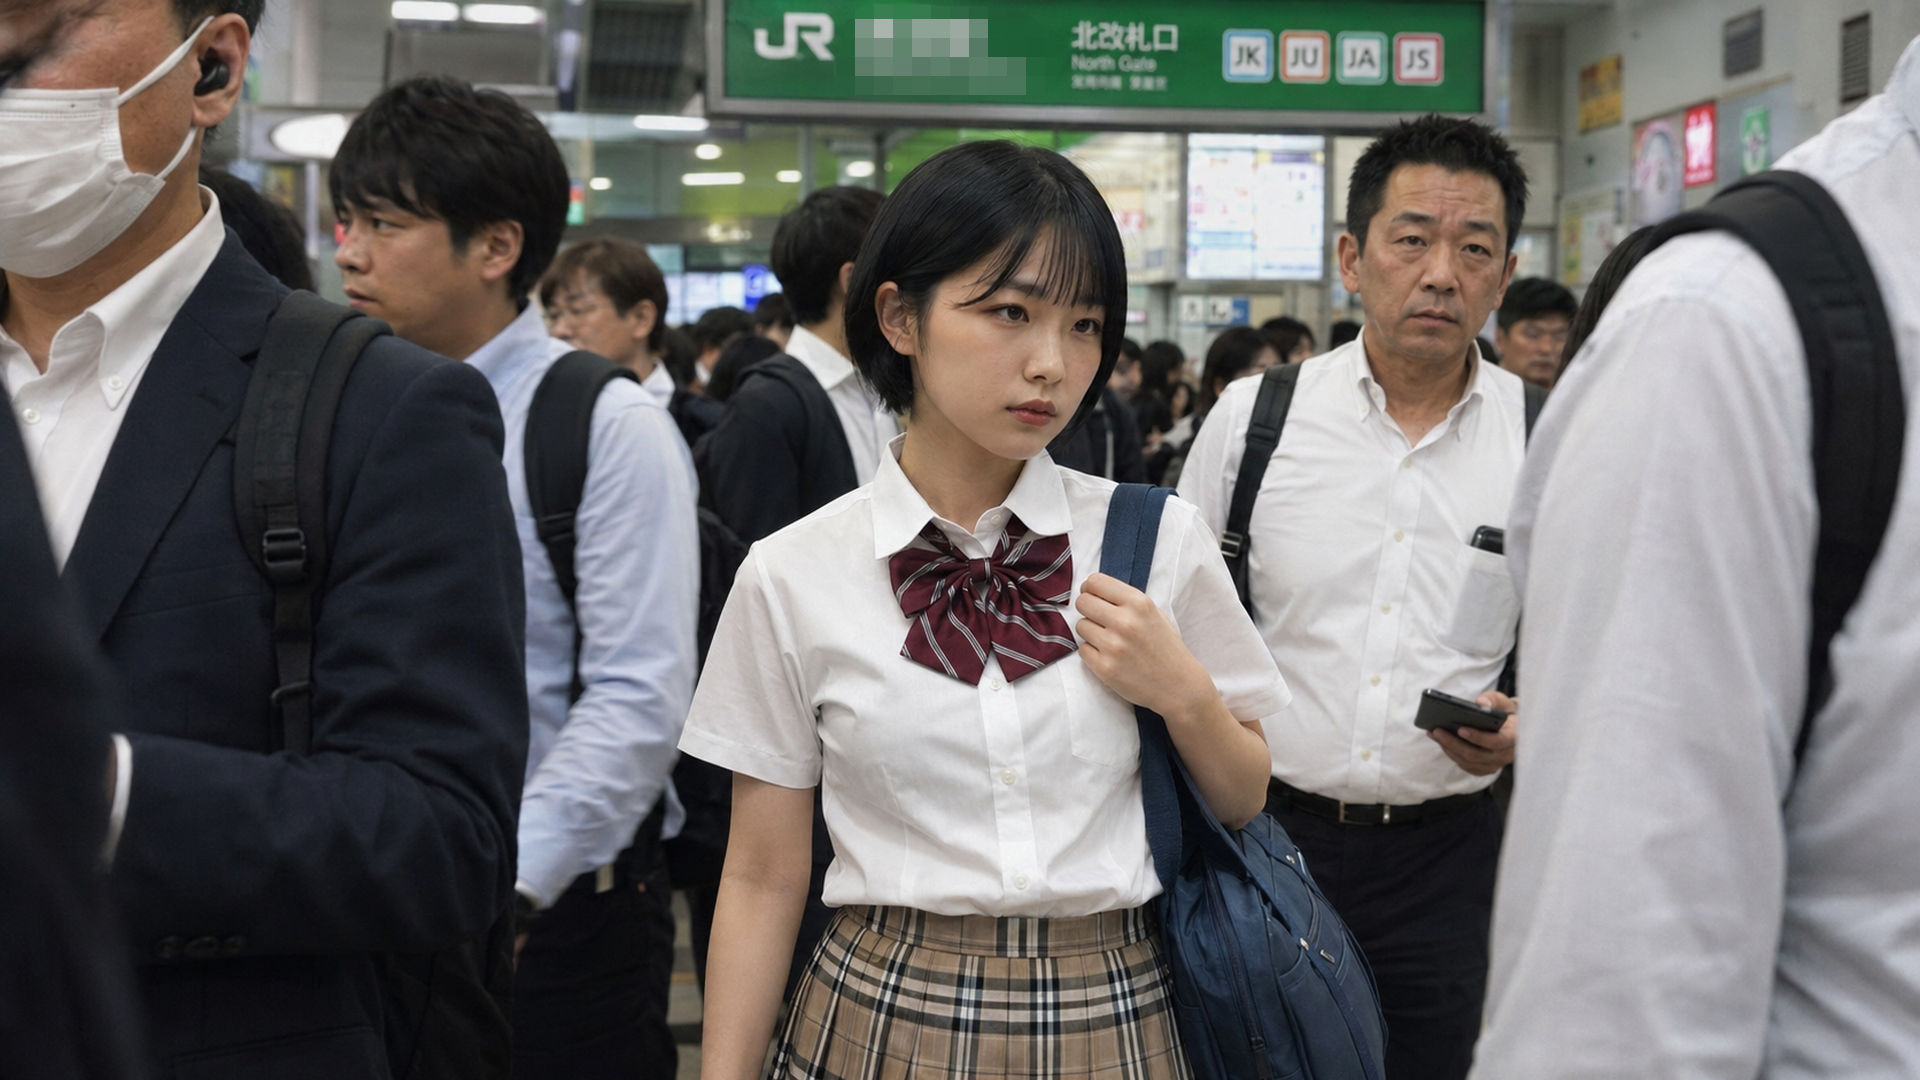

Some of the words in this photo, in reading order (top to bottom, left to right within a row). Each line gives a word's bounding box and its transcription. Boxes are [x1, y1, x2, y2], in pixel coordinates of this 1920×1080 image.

[754, 11, 835, 61] JR
[1071, 20, 1178, 51] 北改札口
[1071, 54, 1116, 71] North
[1118, 54, 1158, 72] Gate
[1235, 45, 1261, 67] JK
[1290, 46, 1319, 68] JU
[1348, 48, 1377, 69] JA
[1406, 48, 1430, 71] JS
